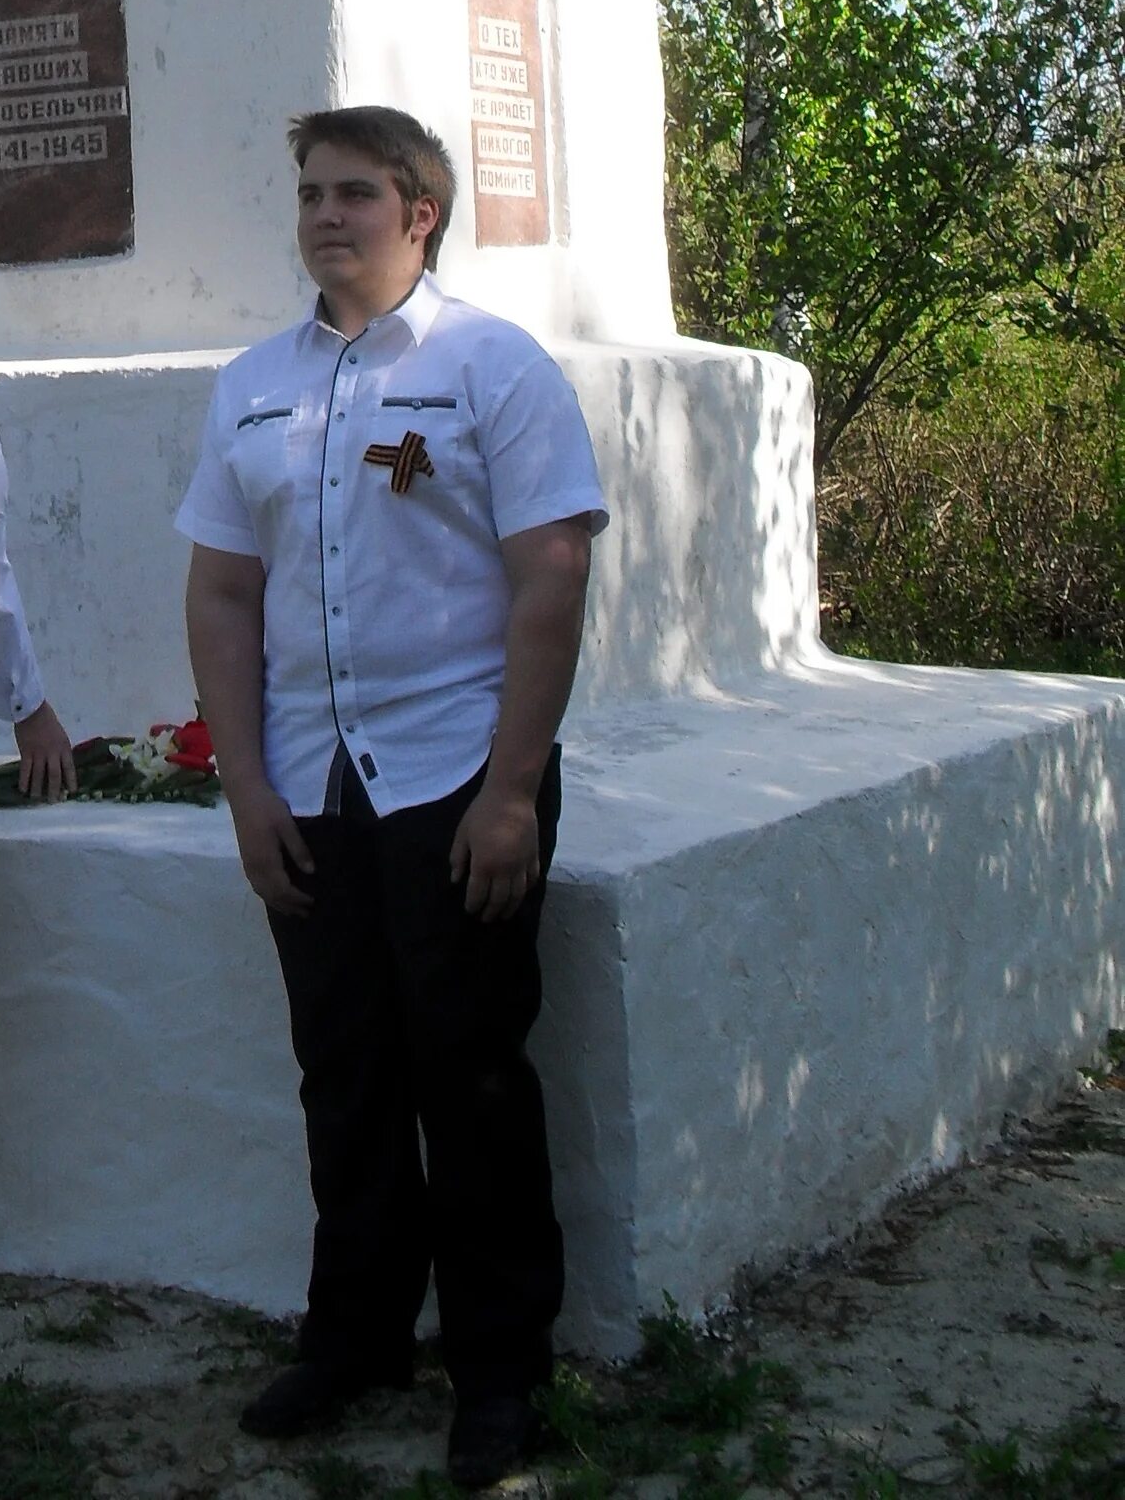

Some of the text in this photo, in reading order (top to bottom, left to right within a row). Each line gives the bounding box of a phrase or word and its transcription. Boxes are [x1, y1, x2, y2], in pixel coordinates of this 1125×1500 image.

[481, 23, 489, 44] О
[475, 61, 525, 85] КТО УЖЕ
[473, 98, 486, 114] НЕ
[480, 135, 530, 156] НИКОГДА
